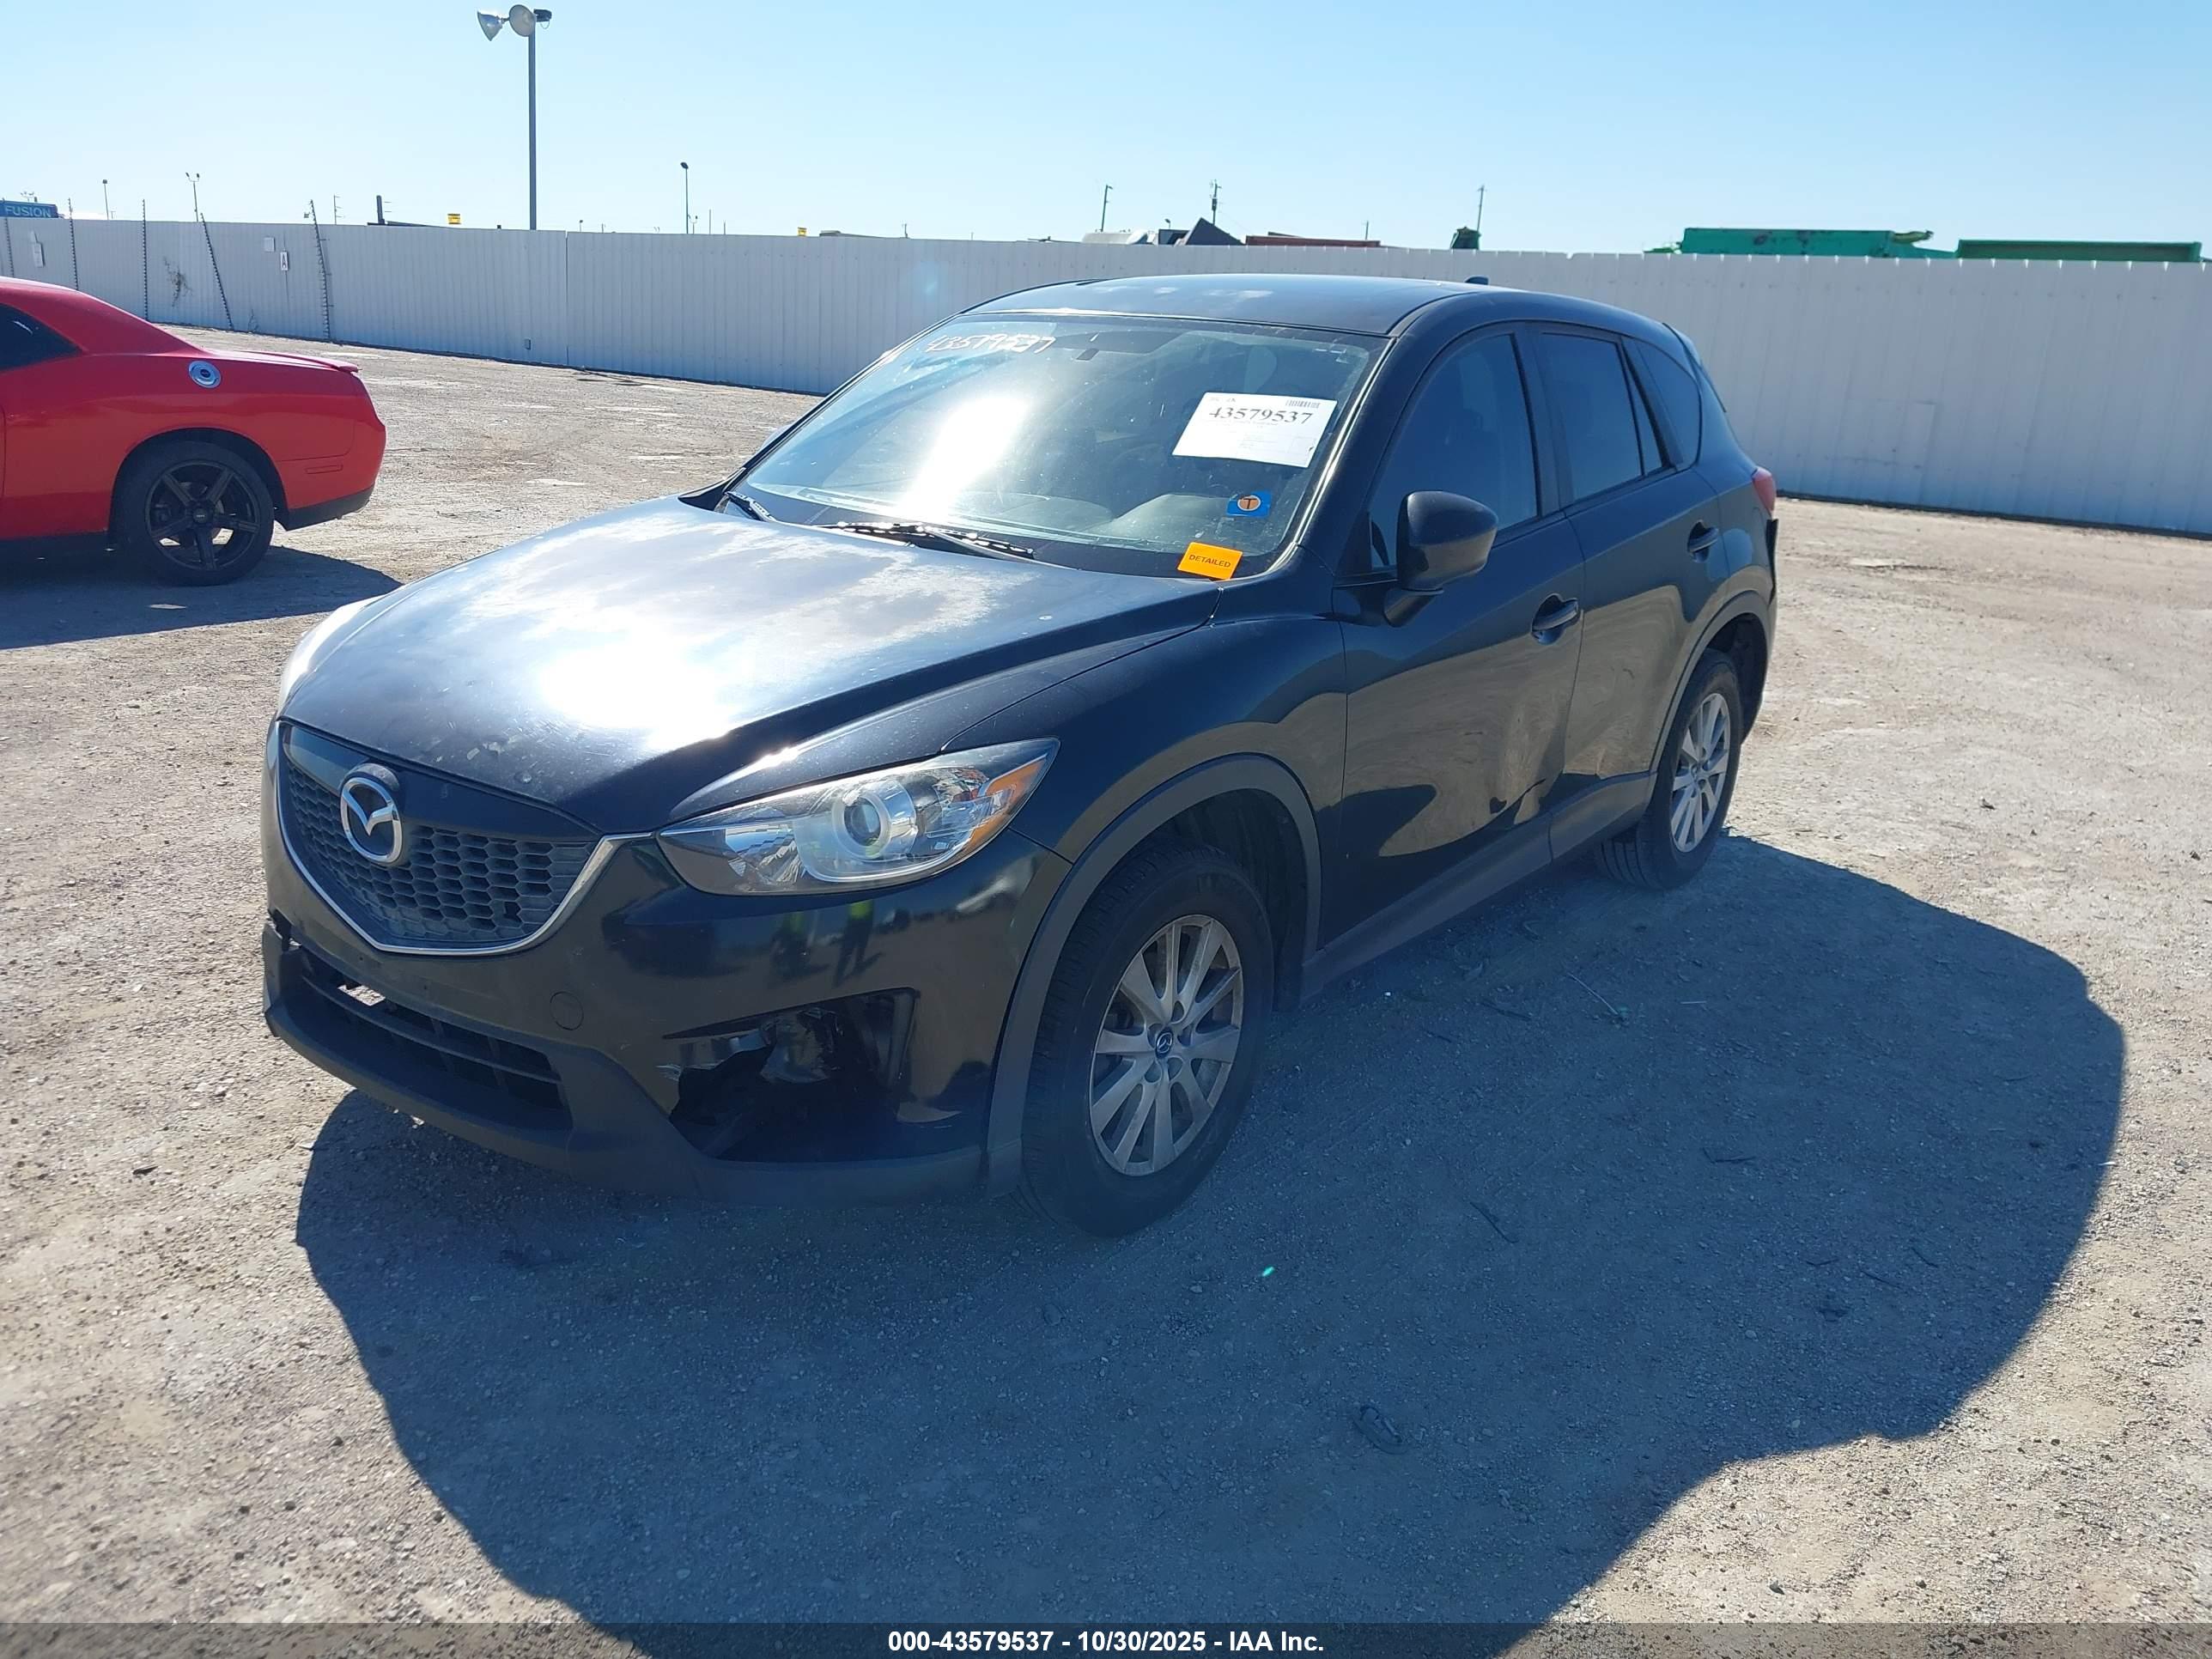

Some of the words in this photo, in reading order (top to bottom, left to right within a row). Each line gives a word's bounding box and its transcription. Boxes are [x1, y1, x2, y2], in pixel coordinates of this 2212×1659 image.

[5, 205, 52, 218] FUSION
[1209, 406, 1313, 424] 43579537
[1188, 554, 1231, 568] DETAILED
